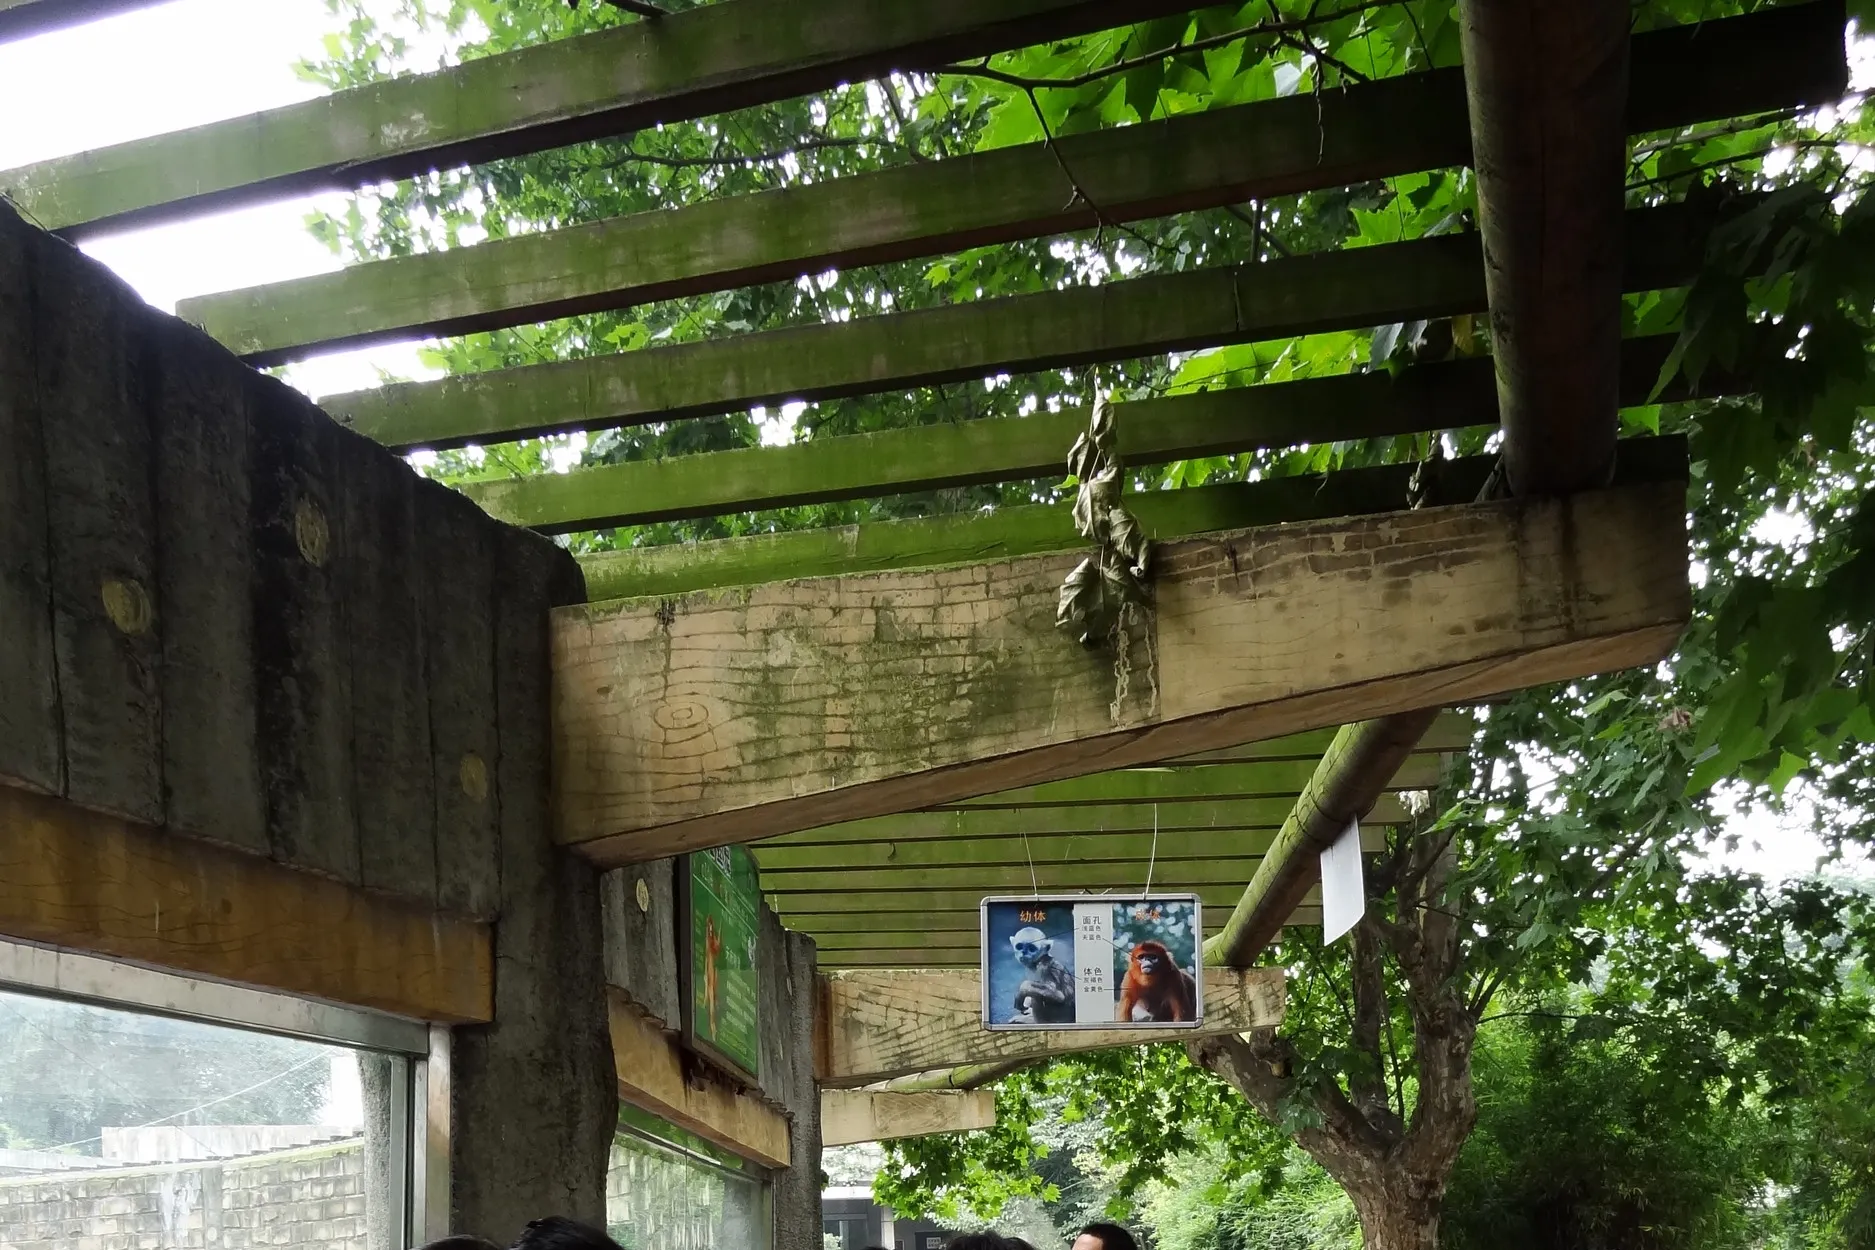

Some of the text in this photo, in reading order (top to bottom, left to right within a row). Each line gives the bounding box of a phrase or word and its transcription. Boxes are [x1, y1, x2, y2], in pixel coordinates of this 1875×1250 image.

[1020, 910, 1046, 922] 幼体
[1082, 915, 1101, 925] 面孔
[1083, 967, 1103, 977] 体色
